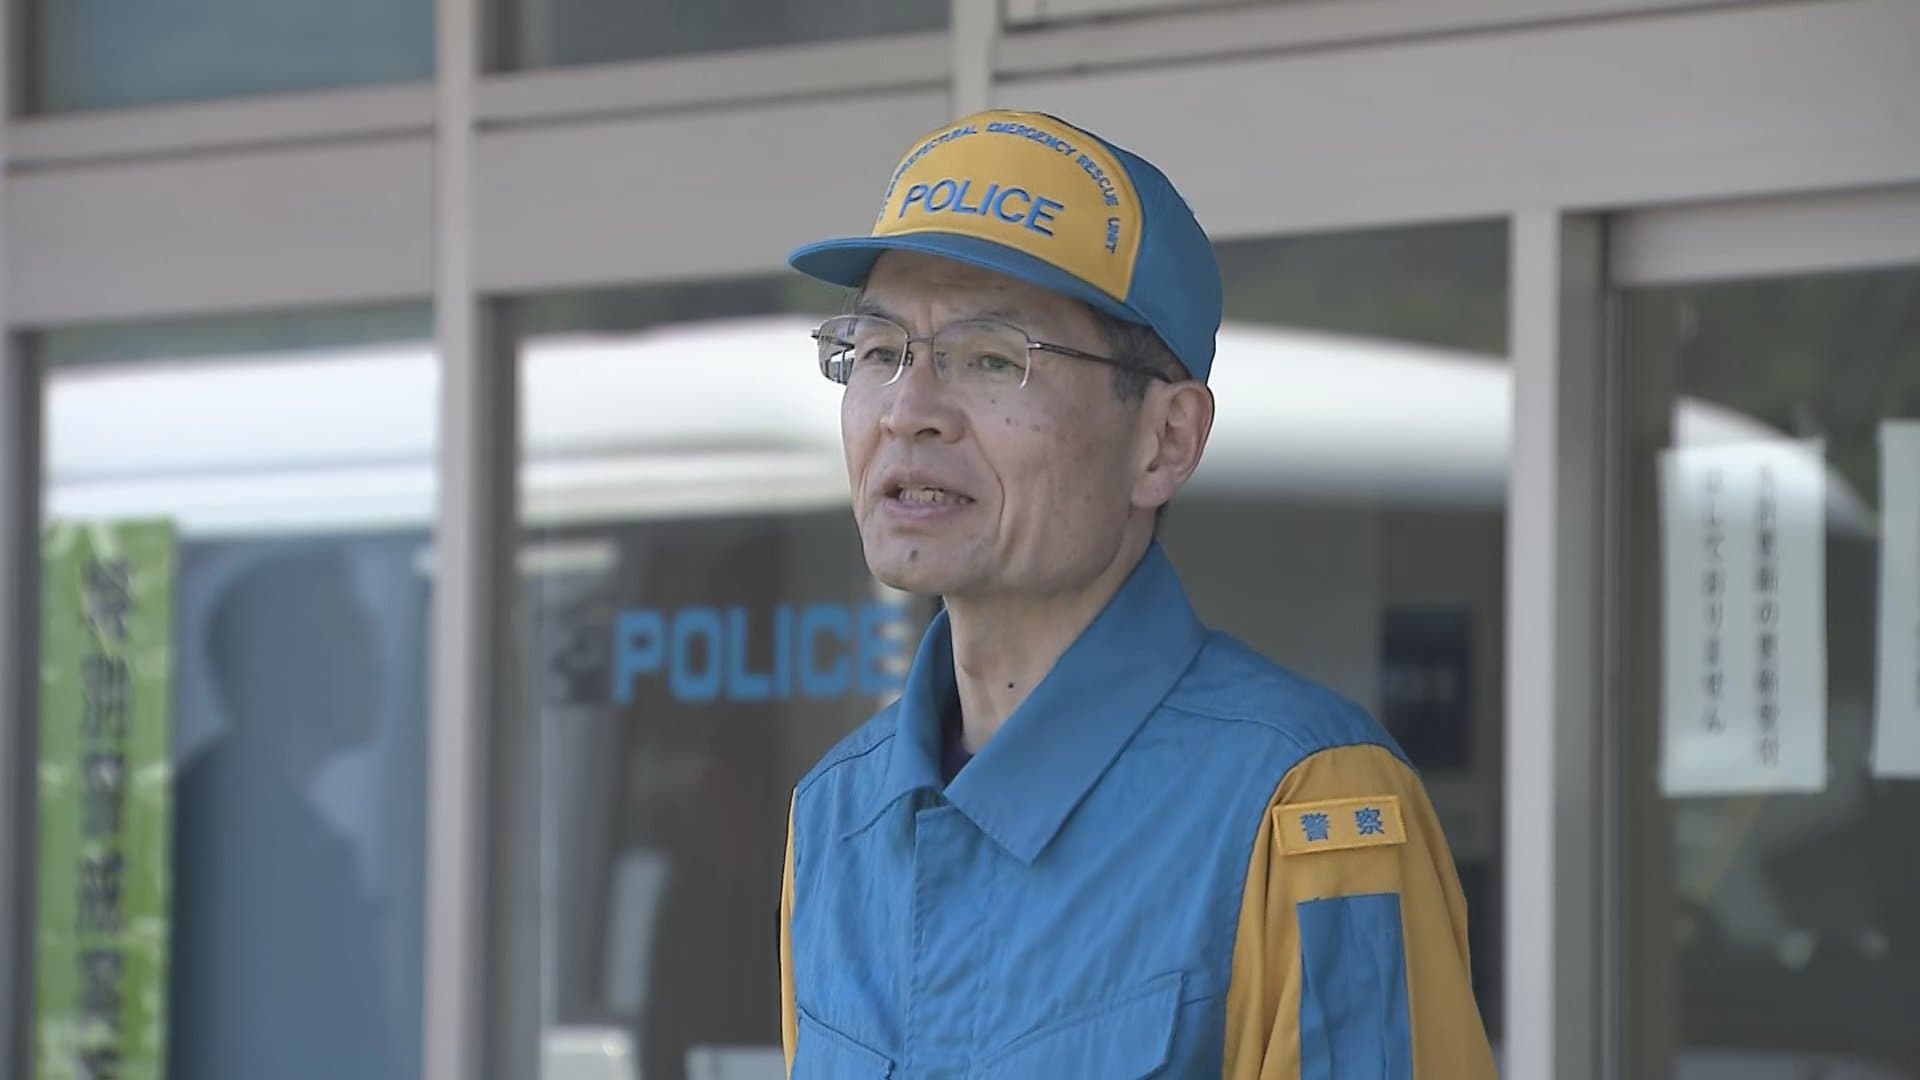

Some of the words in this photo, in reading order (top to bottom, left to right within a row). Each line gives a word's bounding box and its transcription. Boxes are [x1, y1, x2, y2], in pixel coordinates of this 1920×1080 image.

[899, 179, 1065, 238] POLICE
[985, 122, 1077, 157] EMERGENCY
[1076, 154, 1120, 208] RESCUE
[1106, 216, 1121, 254] UNIT
[613, 602, 907, 706] POLICE
[1299, 807, 1385, 842] 警察
